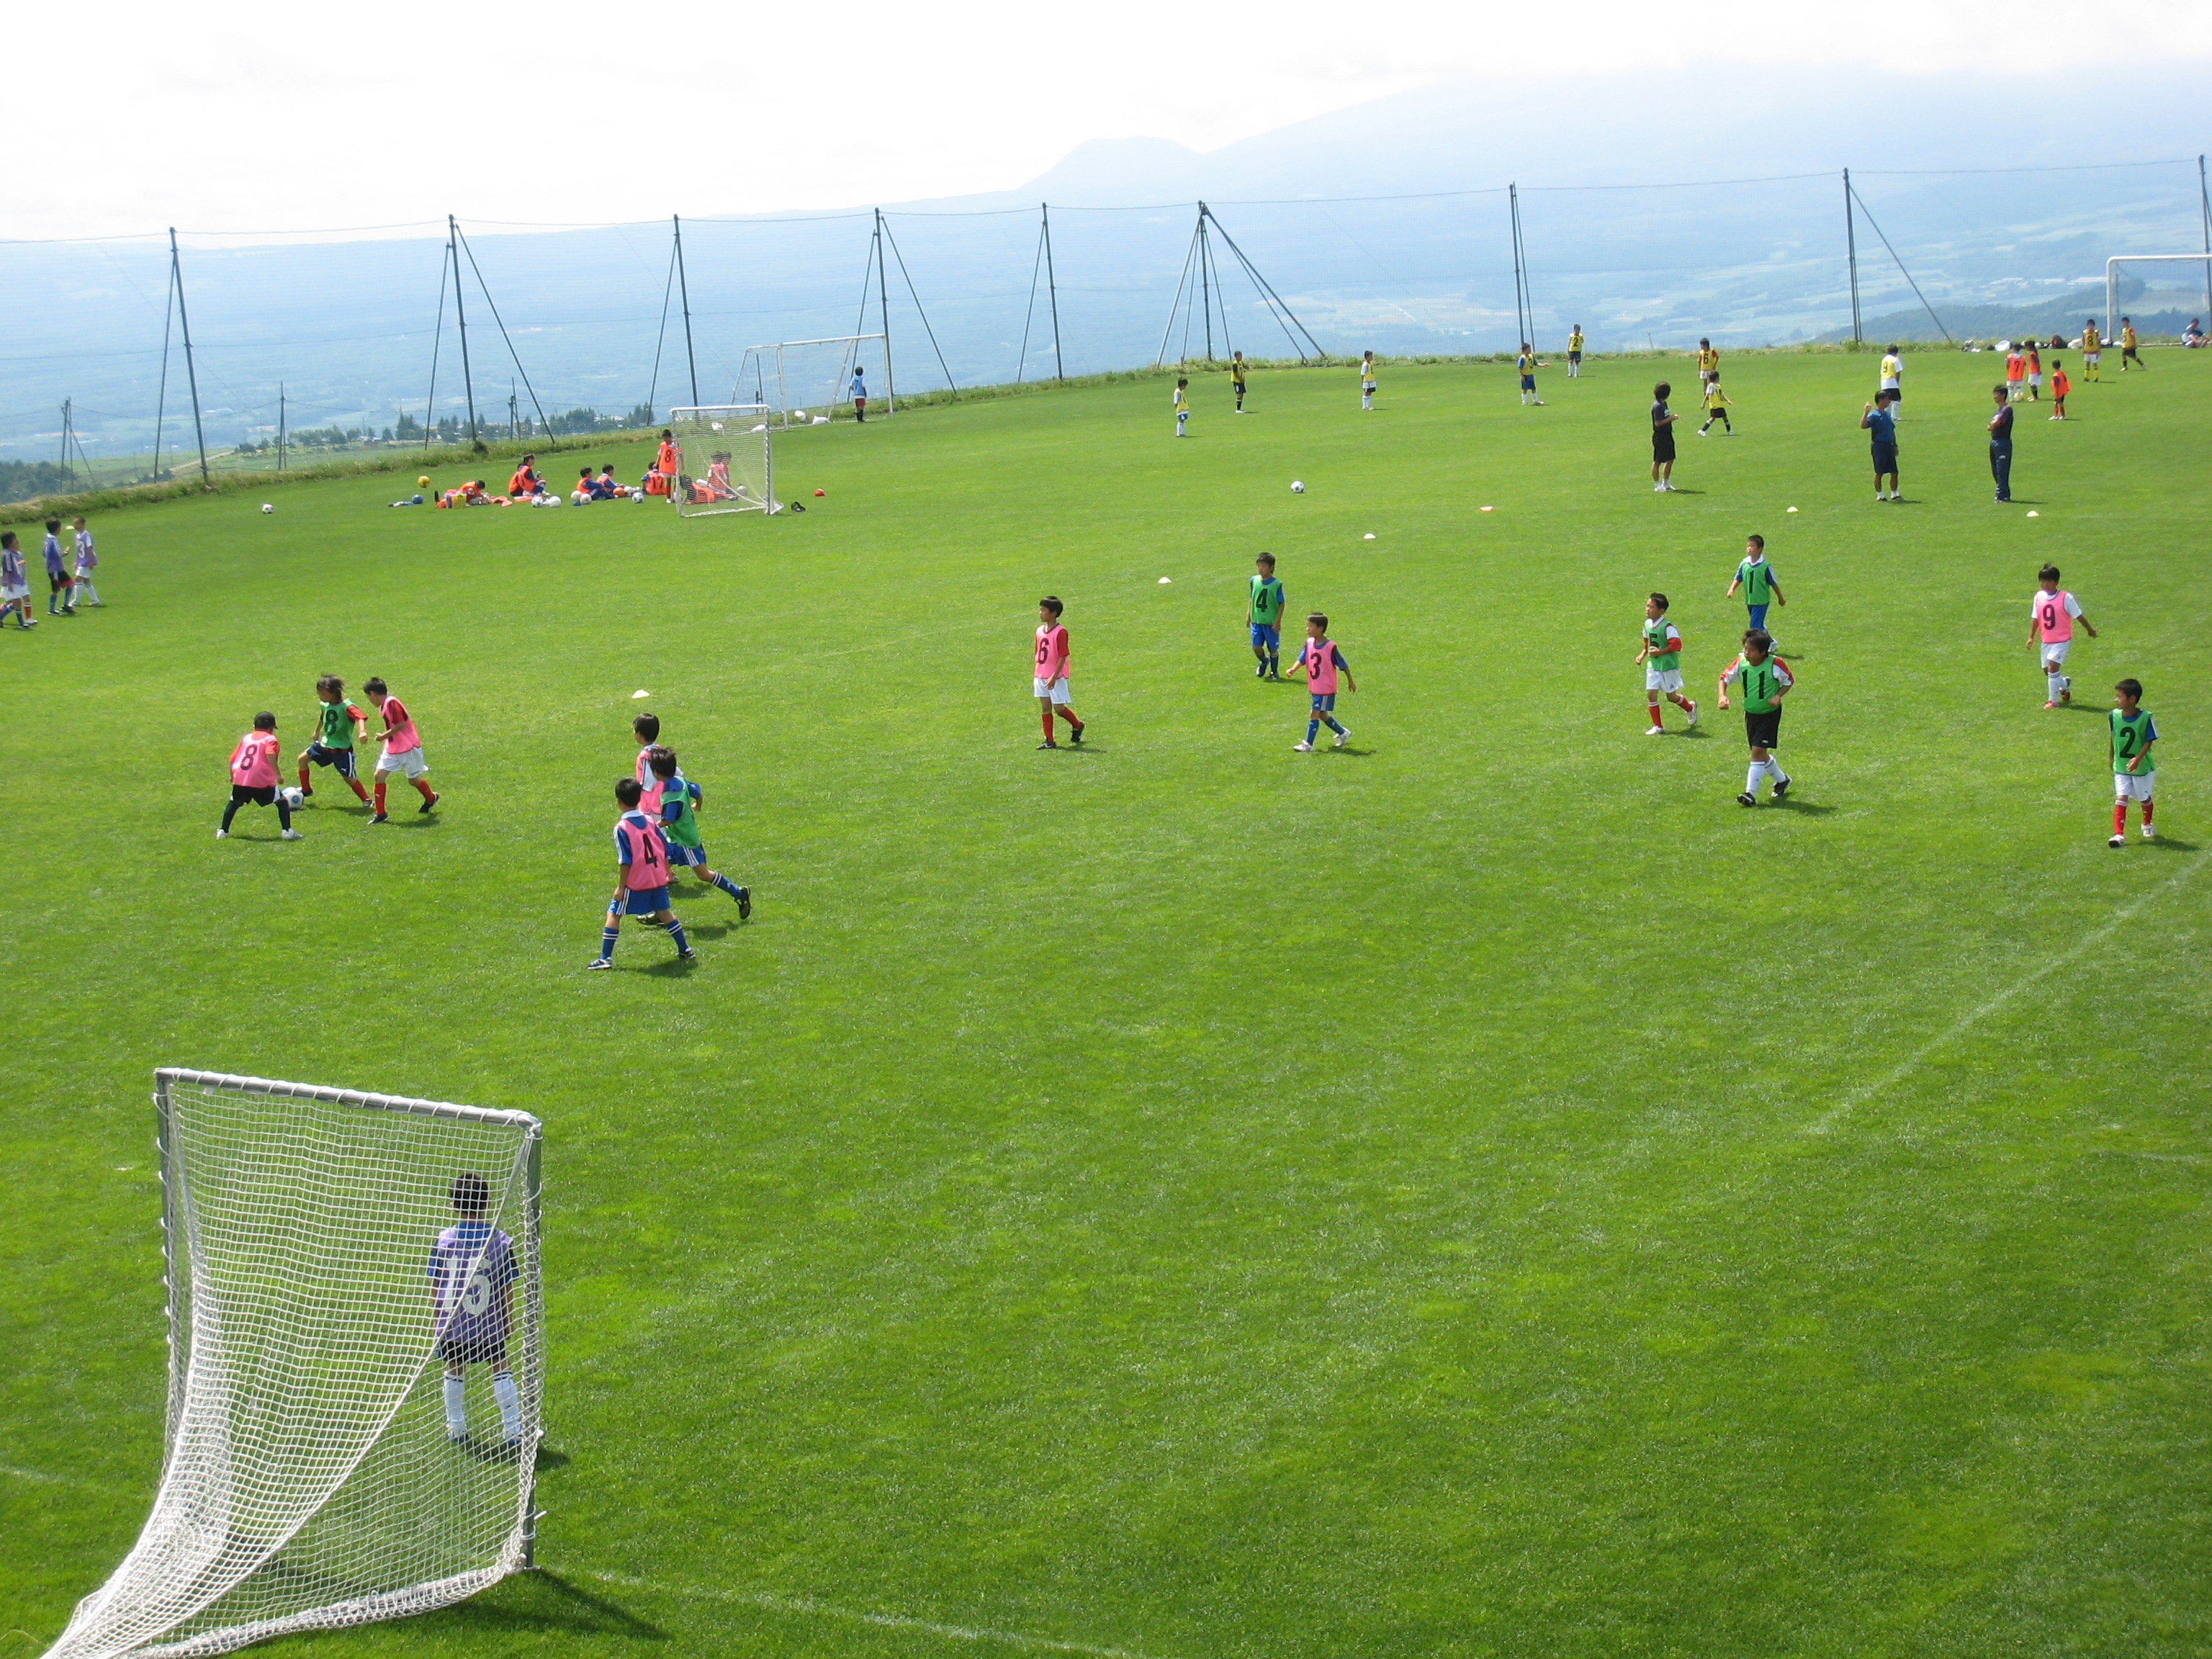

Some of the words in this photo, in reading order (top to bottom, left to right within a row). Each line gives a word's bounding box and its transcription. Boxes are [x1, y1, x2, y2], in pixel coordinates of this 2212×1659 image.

[1574, 337, 1578, 347] 2
[1703, 353, 1709, 364] 6
[2014, 361, 2020, 372] 7
[665, 449, 671, 462] 8
[1749, 570, 1754, 593] 1
[1256, 588, 1268, 612] 4
[2043, 604, 2056, 630] 9
[1038, 638, 1049, 665] 6
[1310, 653, 1322, 680] 3
[1742, 669, 1766, 699] 11
[325, 710, 338, 736] 8
[2119, 727, 2136, 758] 2
[240, 745, 258, 770] 8
[643, 833, 658, 868] 4
